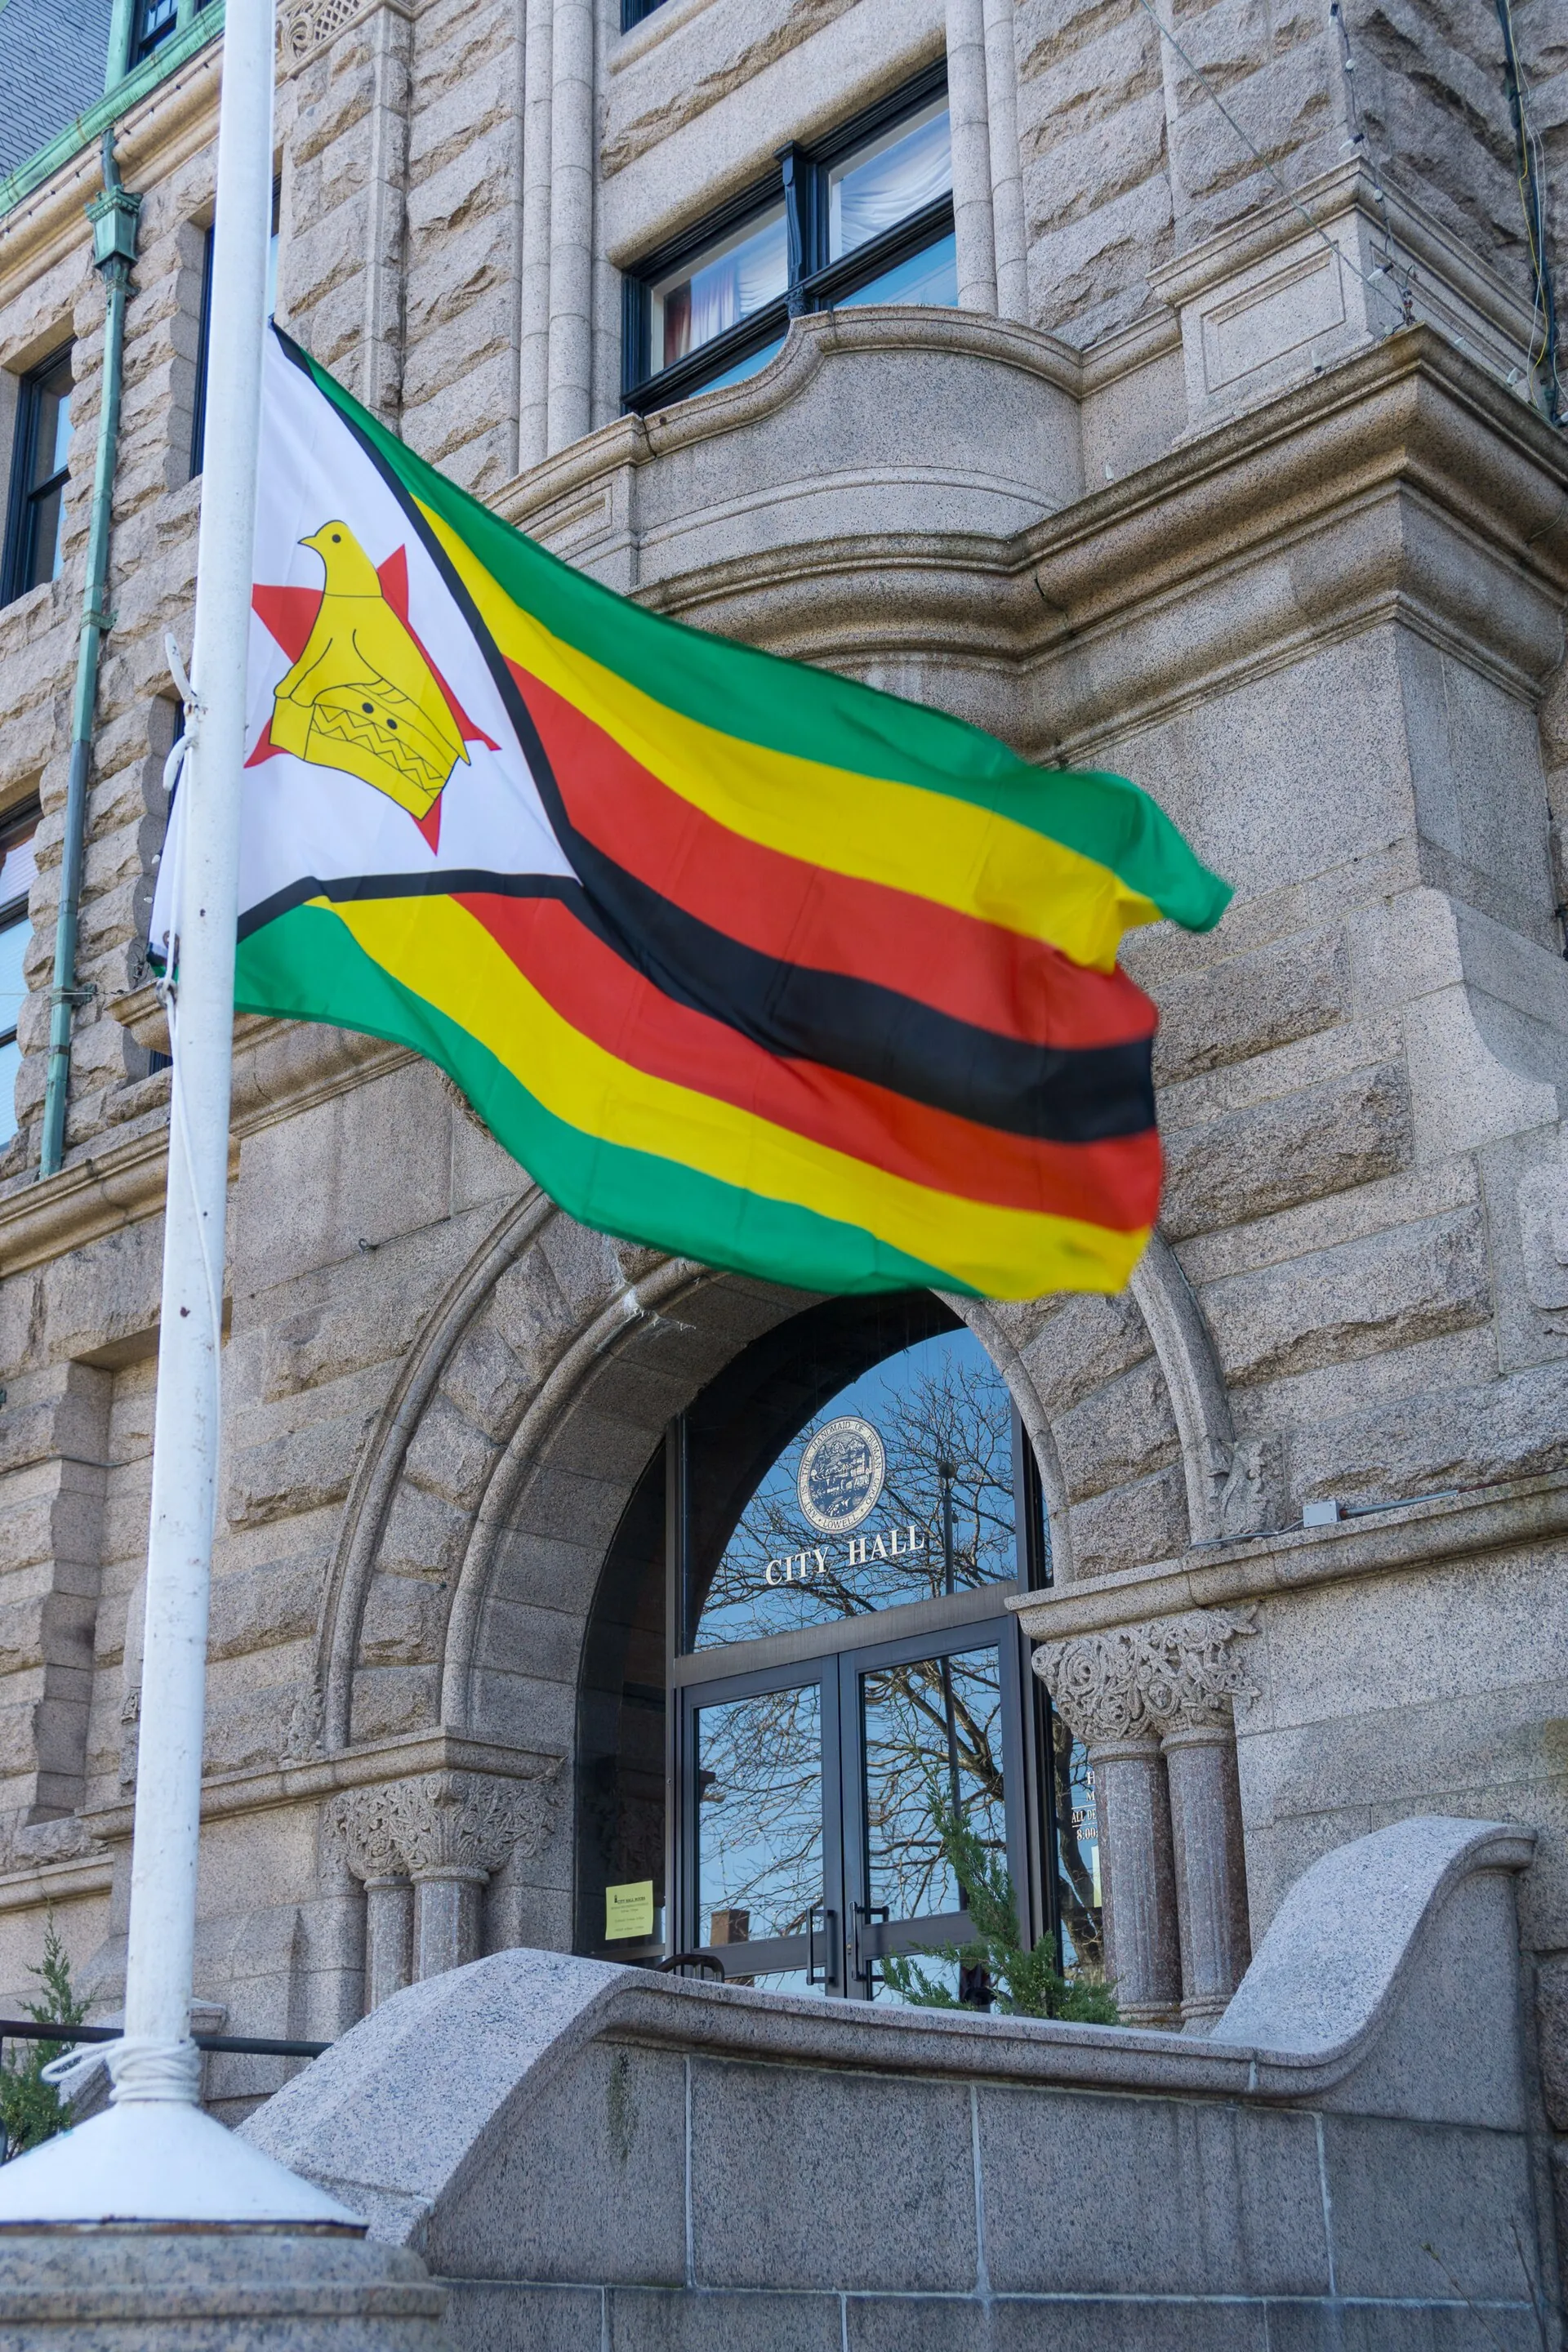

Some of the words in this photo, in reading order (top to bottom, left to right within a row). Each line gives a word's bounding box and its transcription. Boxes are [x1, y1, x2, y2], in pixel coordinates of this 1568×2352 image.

[811, 1421, 850, 1450] HANDMAID
[854, 1423, 864, 1432] OF
[866, 1433, 882, 1469] HUMAN
[802, 1456, 811, 1477] THE
[866, 1477, 880, 1505] GOOD
[804, 1501, 817, 1519] ART
[822, 1514, 858, 1528] LOWELL
[765, 1546, 830, 1586] CITY
[848, 1524, 924, 1566] HALL
[1071, 1810, 1085, 1824] ALL
[1076, 1827, 1098, 1841] 8:00
